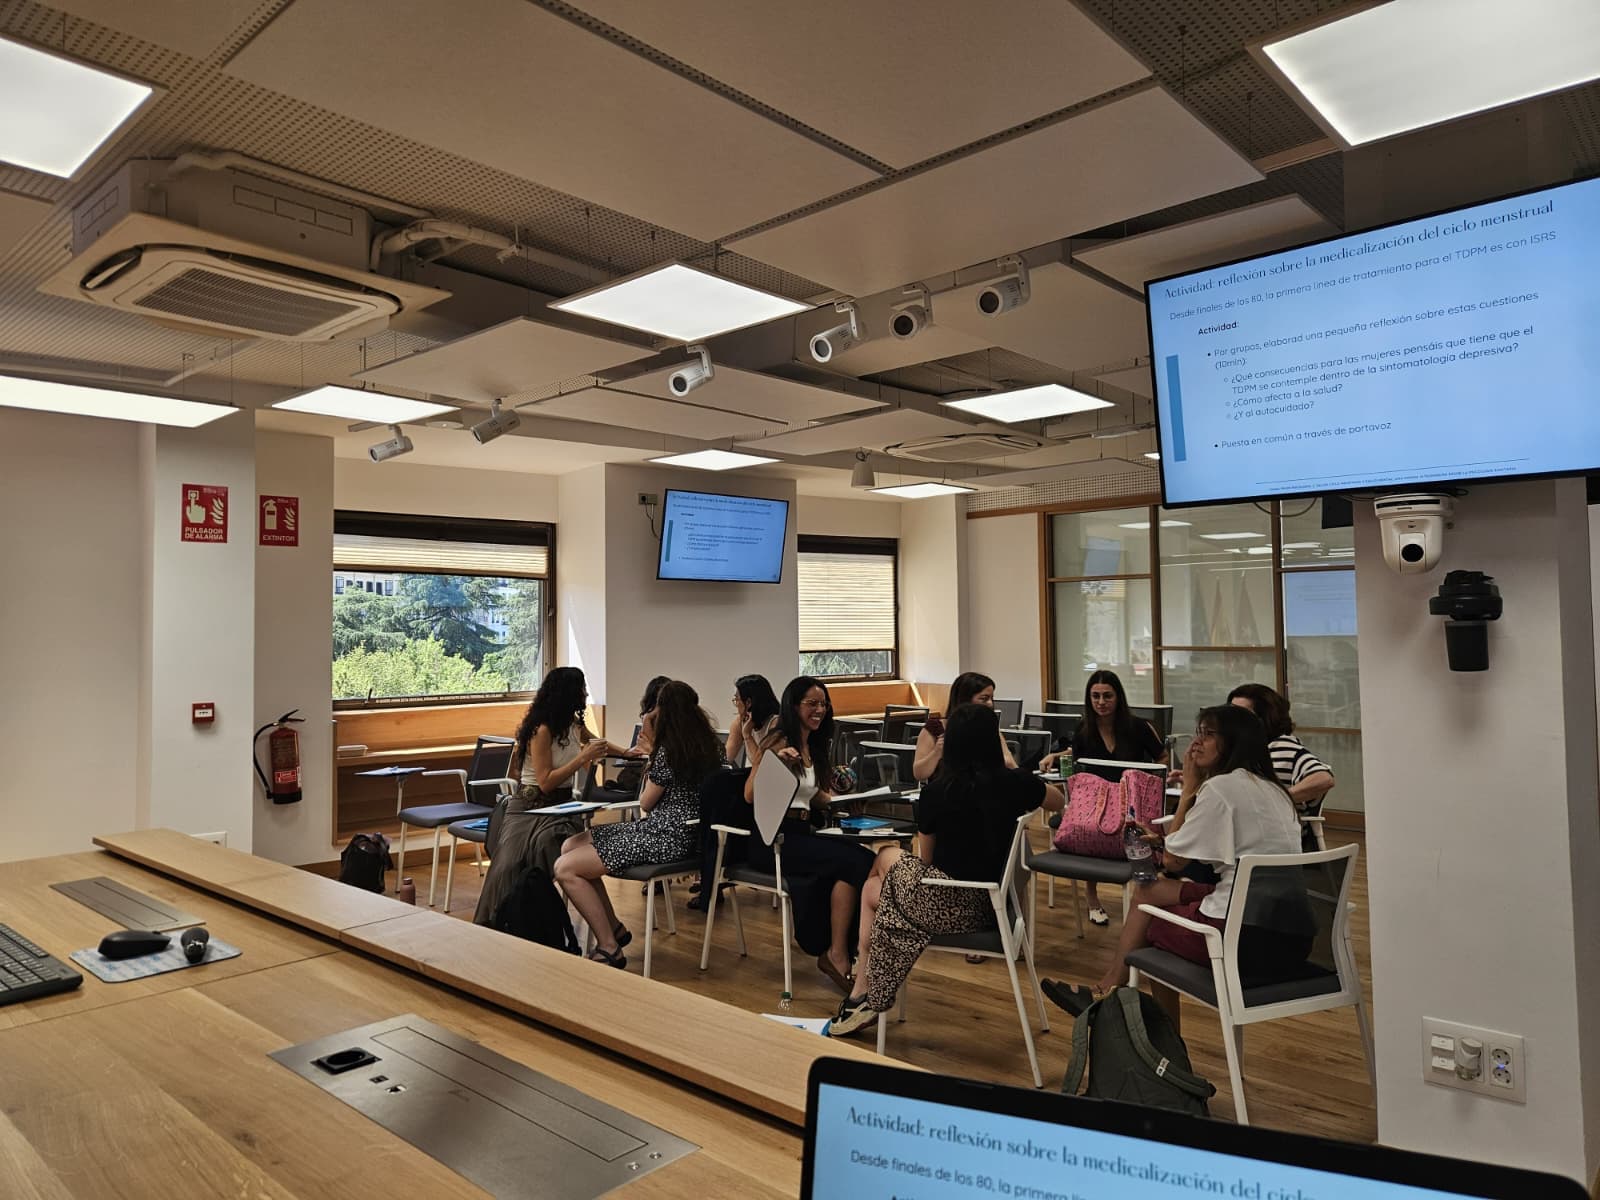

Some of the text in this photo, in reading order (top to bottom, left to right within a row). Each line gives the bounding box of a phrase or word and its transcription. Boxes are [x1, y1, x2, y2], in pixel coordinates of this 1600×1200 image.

[1164, 200, 1554, 298] Actividad: reflexión sobre la medicalización del ciclo menstrual
[1169, 306, 1195, 321] Desde
[1197, 301, 1223, 316] finales
[1225, 299, 1236, 310] de
[1237, 295, 1250, 306] los
[1251, 293, 1264, 304] 80,
[1265, 290, 1275, 300] la
[1276, 284, 1312, 301] primera
[1338, 275, 1351, 285] de
[1353, 263, 1412, 282] tratamiento
[1415, 256, 1441, 271] para
[1442, 252, 1452, 264] el
[1455, 246, 1487, 260] TDPM
[1490, 242, 1503, 253] es
[1506, 238, 1527, 249] con
[1530, 231, 1557, 245] ISRS
[1198, 321, 1240, 336] Actividad:
[1214, 292, 1539, 358] Por grupos, elaborad una pequeña reflexión sobre estas cuestiones
[1231, 325, 1534, 384] ¿Qué consecuencias para las mujeres pensáis que tiene que el
[1232, 342, 1519, 395] TDPM se contemple dentro de la sintomatología depresiva?
[1233, 400, 1315, 421] ¿Y al autocuidado?
[1264, 392, 1292, 402] afecta
[1302, 388, 1311, 397] la
[1313, 384, 1343, 396] salud?
[1221, 422, 1392, 449] Puesta en común a través de portavoz
[262, 534, 295, 542] EXTINTOR
[846, 1106, 925, 1137] Actividad:
[929, 1124, 1002, 1151] reflexión
[1006, 1139, 1057, 1162] sobre
[1062, 1146, 1078, 1166] la
[1083, 1154, 1224, 1194] medicalización
[851, 1149, 889, 1169] Desde
[891, 1157, 932, 1178] finales
[935, 1167, 951, 1182] de
[955, 1169, 973, 1187] los
[976, 1175, 996, 1192] 80,
[999, 1179, 1011, 1194] la
